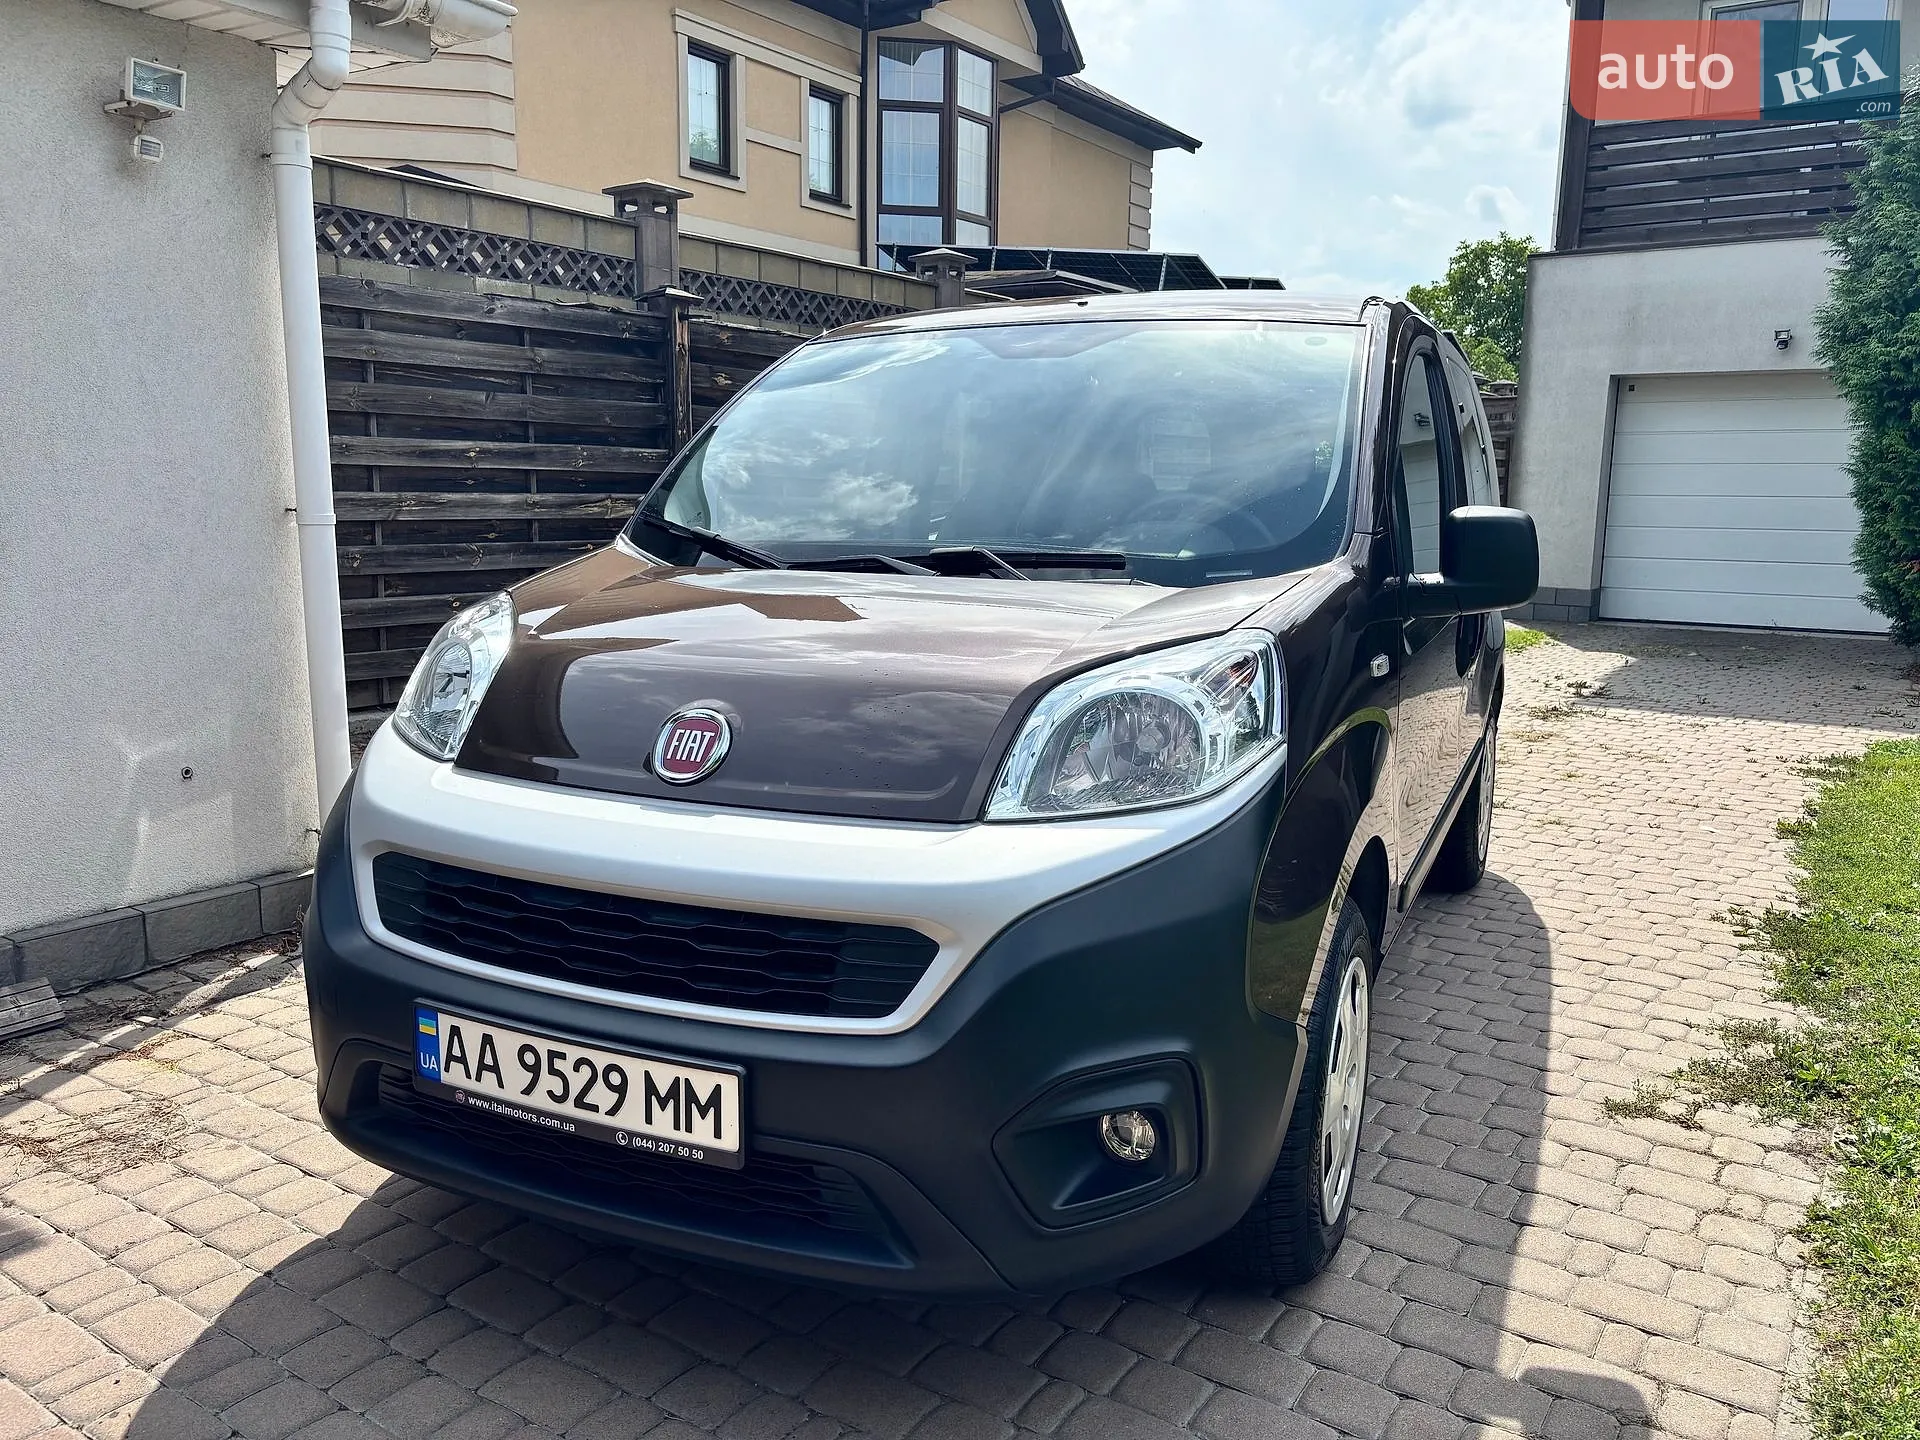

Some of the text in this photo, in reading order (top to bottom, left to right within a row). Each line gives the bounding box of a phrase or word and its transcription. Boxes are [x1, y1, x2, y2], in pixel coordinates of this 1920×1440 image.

[666, 729, 715, 762] FIAT
[420, 1052, 439, 1072] UA
[443, 1024, 722, 1140] AA 9529 MM
[467, 1095, 576, 1132] www.italmotors.com.ua
[632, 1136, 704, 1160] (044) 207 50 50
